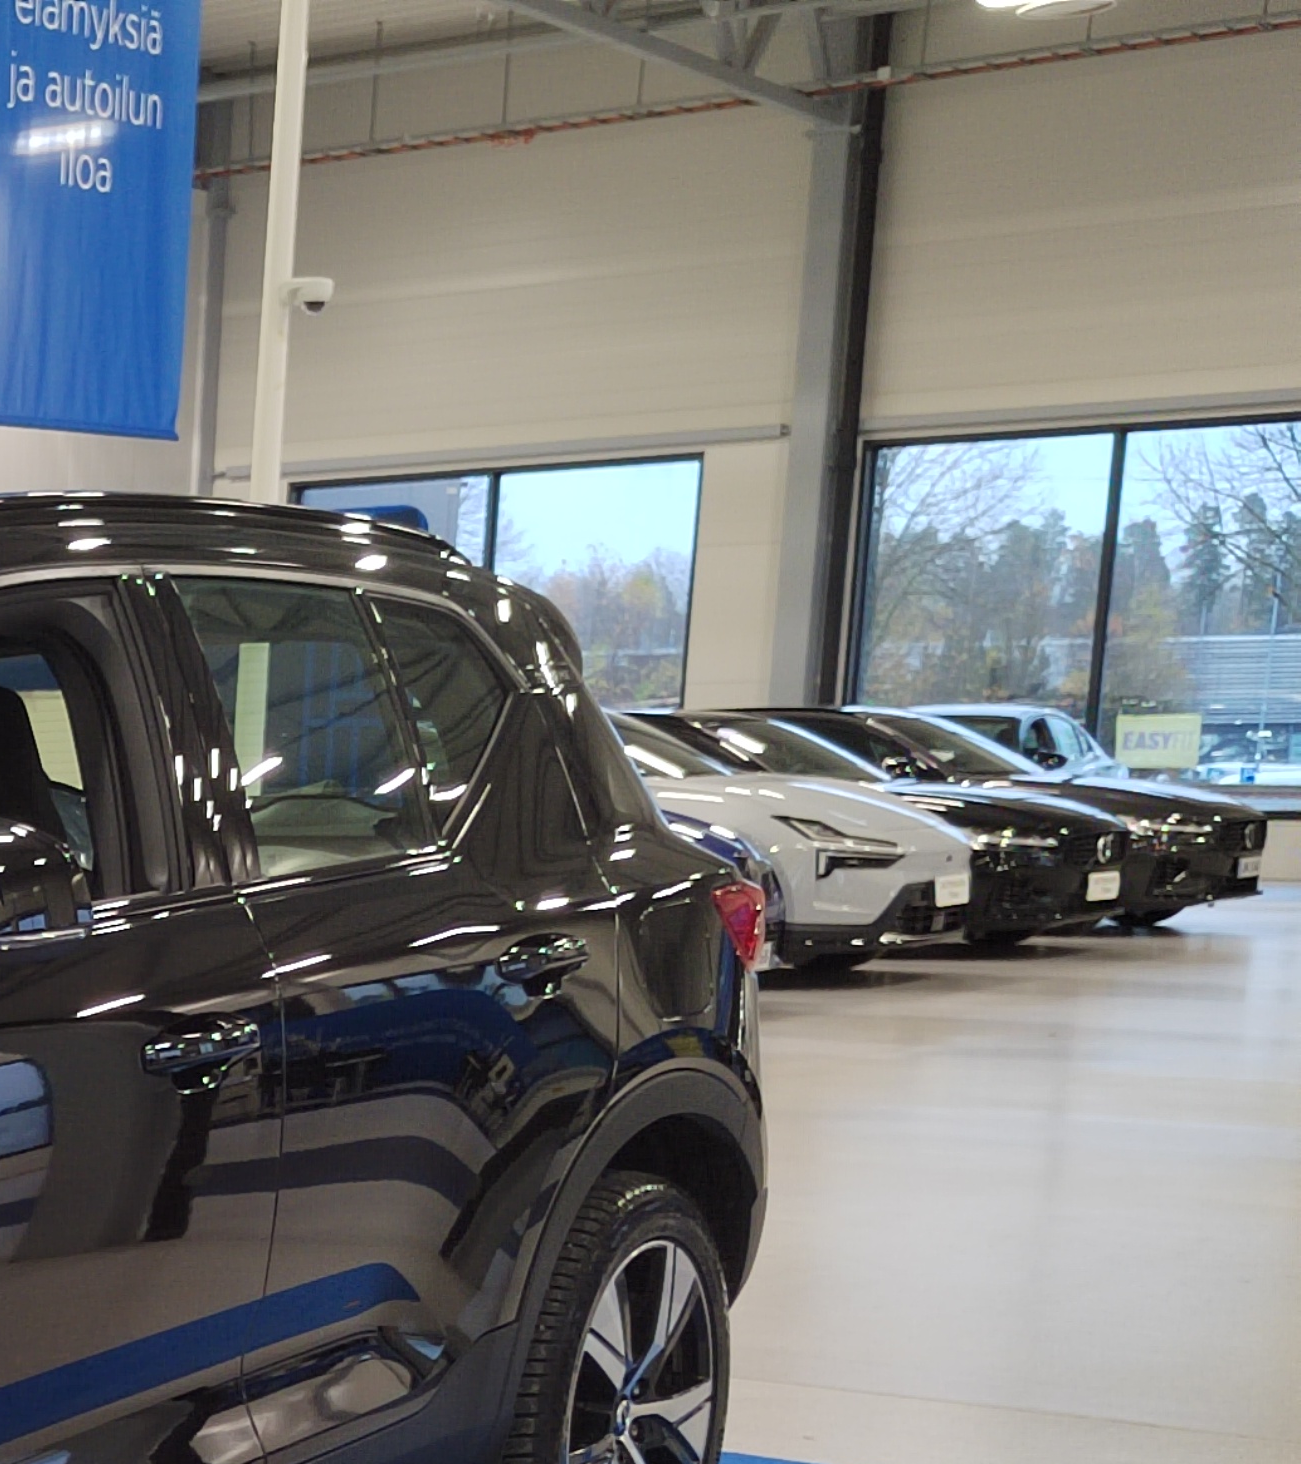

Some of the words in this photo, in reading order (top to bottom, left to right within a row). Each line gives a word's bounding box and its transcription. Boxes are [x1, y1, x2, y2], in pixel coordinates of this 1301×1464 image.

[6, 50, 35, 109] ja
[45, 69, 163, 129] autoilun
[60, 142, 113, 193] iloa
